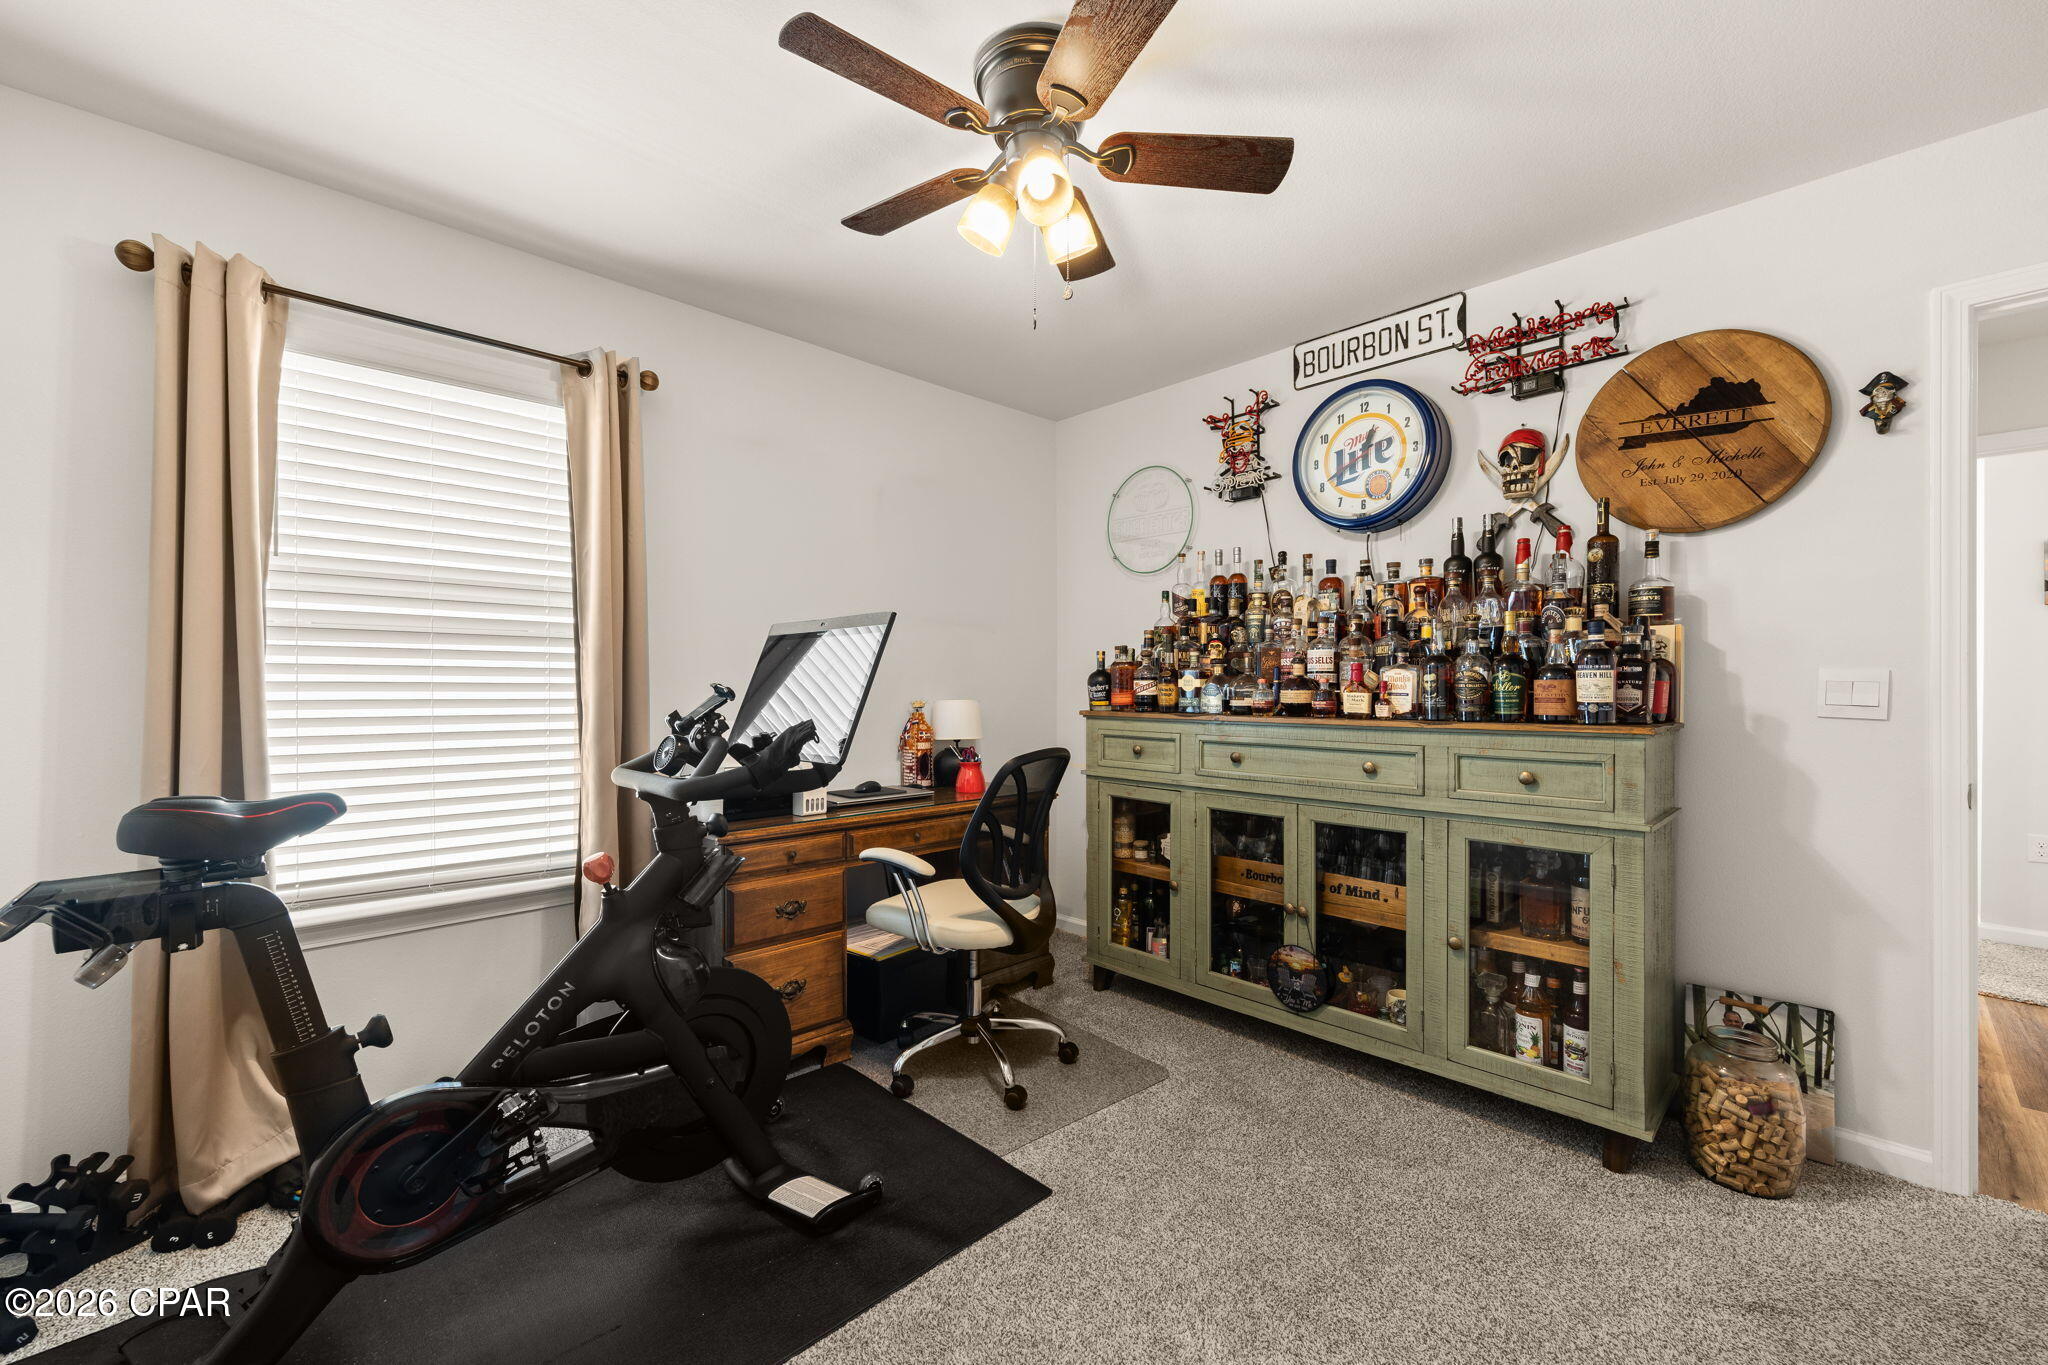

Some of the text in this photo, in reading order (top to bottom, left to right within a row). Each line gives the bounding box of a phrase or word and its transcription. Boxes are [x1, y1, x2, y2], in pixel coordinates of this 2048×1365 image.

[1303, 308, 1453, 378] BOURBON ST.
[1512, 336, 1620, 378] Mark
[1360, 401, 1370, 413] 12
[1386, 403, 1391, 414] 1
[1337, 414, 1345, 425] 11
[1404, 416, 1411, 428] 2
[1639, 408, 1752, 435] EVERETT
[1320, 433, 1329, 445] 10
[1412, 440, 1419, 452] 3
[1313, 459, 1319, 470] 9
[1333, 435, 1395, 488] Lite
[1621, 445, 1767, 479] John & Michelle
[1404, 467, 1411, 479] 4
[1663, 474, 1687, 486] July
[1690, 473, 1708, 483] 29,
[1711, 468, 1743, 481] 2020
[1319, 482, 1325, 493] 8
[1337, 497, 1343, 508] 7
[1360, 499, 1367, 510] 6
[1599, 671, 1613, 679] HILL
[1245, 868, 1285, 885] Bourbo
[1329, 883, 1344, 894] of
[1345, 884, 1381, 901] Mind
[491, 981, 576, 1069] PELOTON
